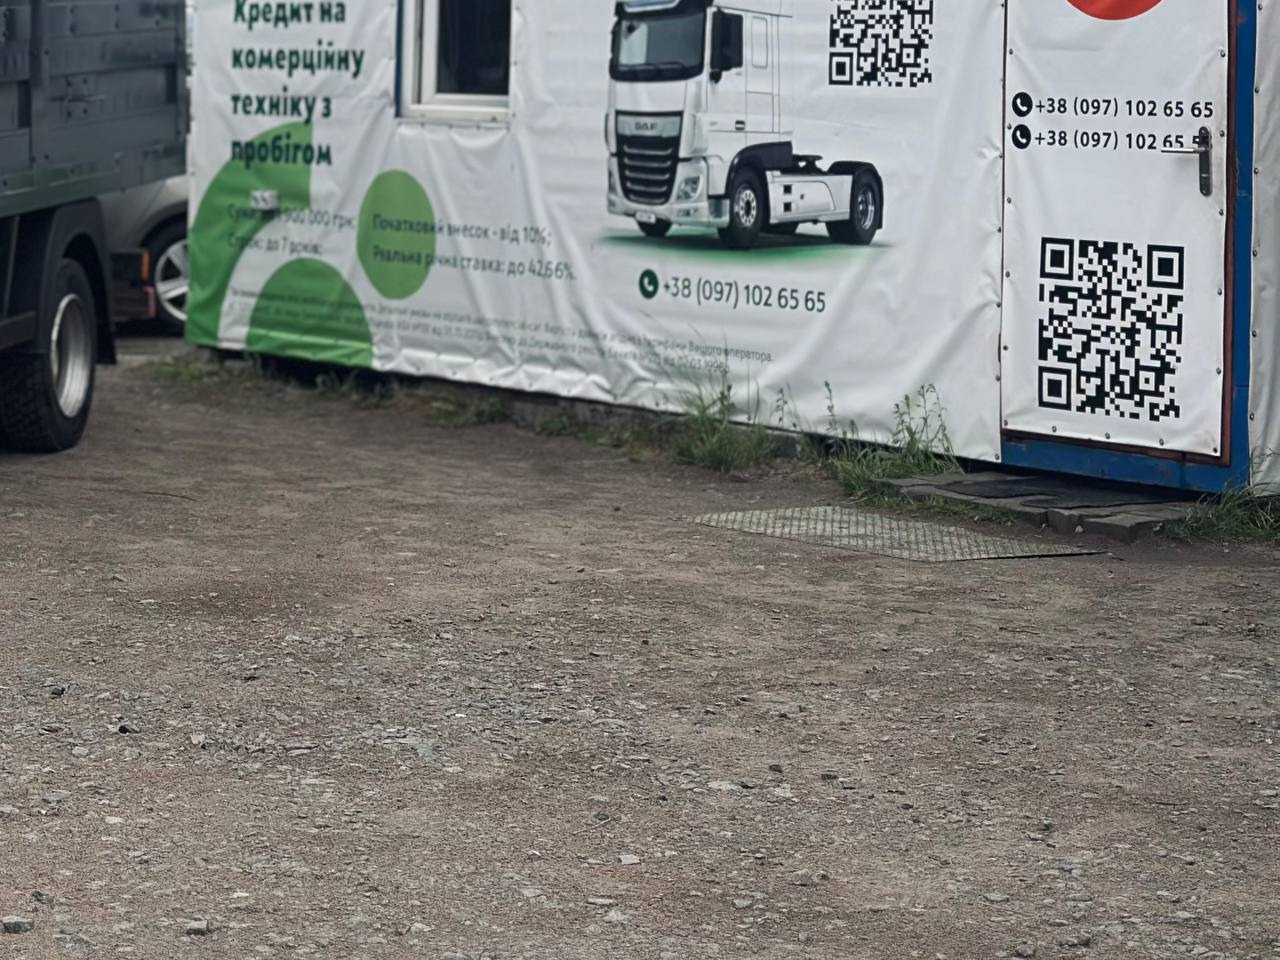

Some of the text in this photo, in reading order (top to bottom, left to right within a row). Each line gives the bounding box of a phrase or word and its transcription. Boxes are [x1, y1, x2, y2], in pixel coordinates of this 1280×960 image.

[319, 1, 346, 23] на
[231, 39, 365, 78] комерційну
[231, 86, 332, 124] техніку з
[1035, 97, 1213, 118] +38 (097) 102 65 65
[231, 133, 332, 168] пробігом
[1034, 130, 1067, 146] +38
[1073, 130, 1119, 149] (097)
[1126, 133, 1157, 149] 102
[1163, 134, 1184, 148] 65
[447, 222, 489, 239] внесок
[500, 224, 521, 245] від
[506, 260, 526, 278] до
[663, 277, 827, 313] +38 (097) 102 65 65
